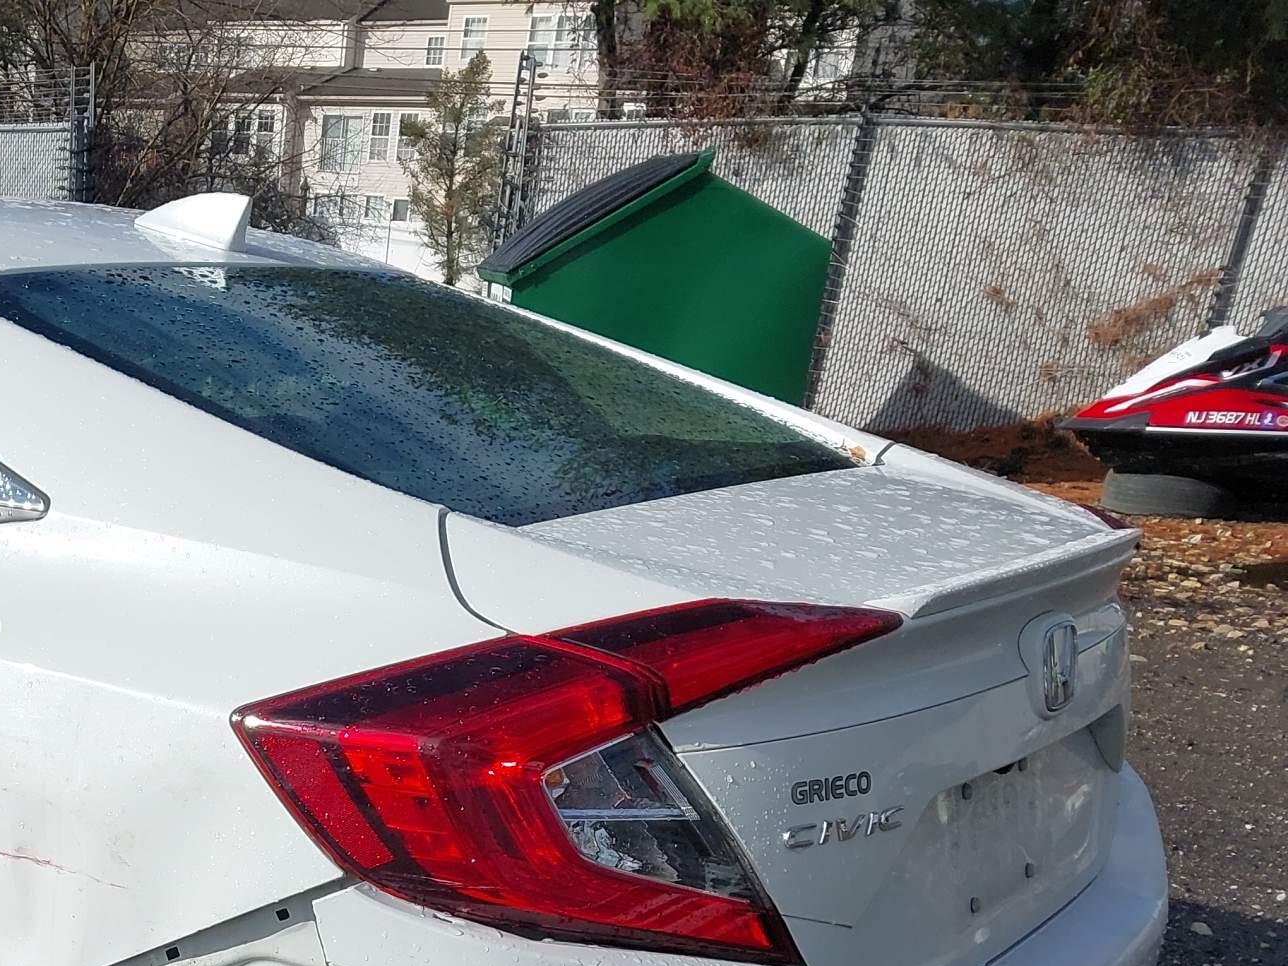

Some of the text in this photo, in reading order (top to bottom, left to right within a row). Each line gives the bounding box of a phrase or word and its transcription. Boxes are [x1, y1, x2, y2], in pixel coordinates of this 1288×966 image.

[1186, 411, 1207, 424] NJ
[1207, 411, 1245, 424] 3687
[791, 770, 872, 806] GRIECO
[782, 805, 905, 850] CIVIC
